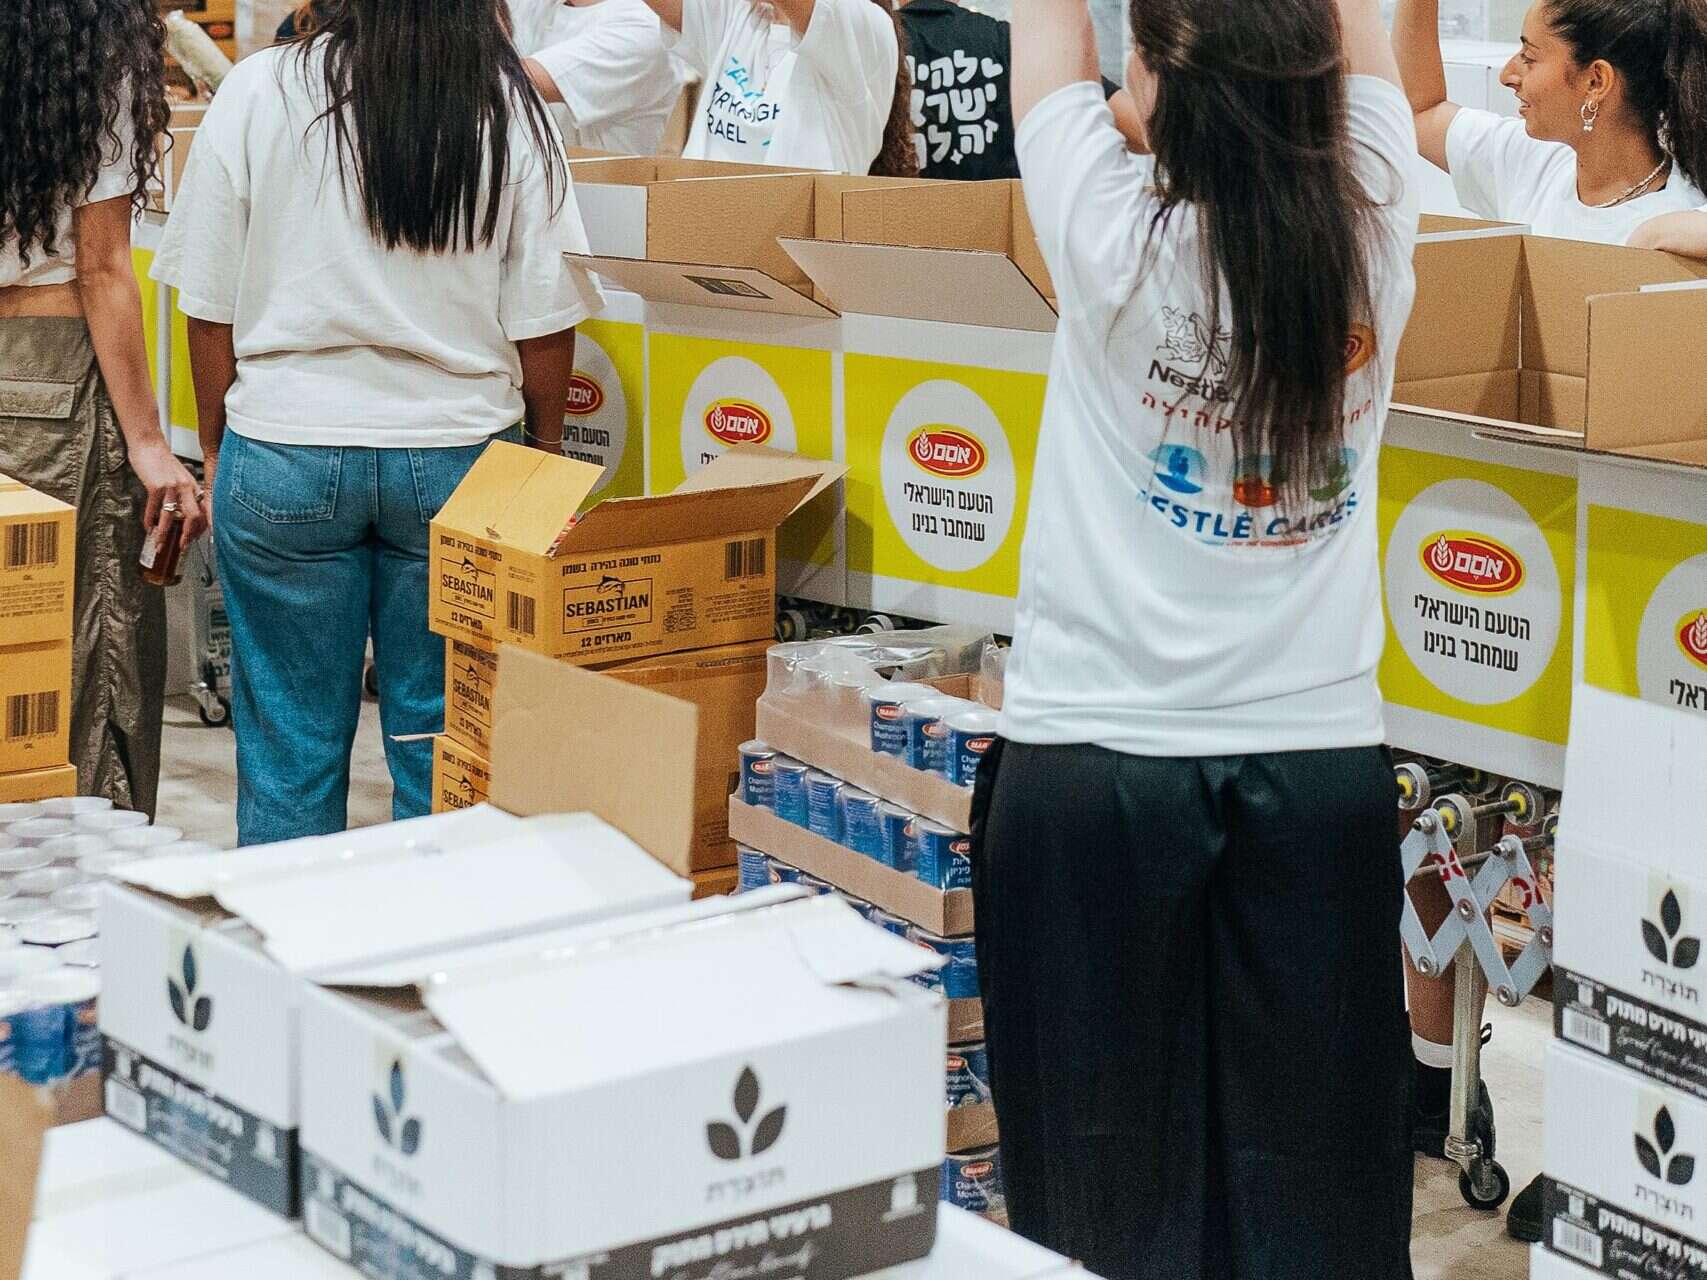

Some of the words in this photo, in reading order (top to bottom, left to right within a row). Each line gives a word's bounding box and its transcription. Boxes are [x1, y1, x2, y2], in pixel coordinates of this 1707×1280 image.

[707, 113, 747, 144] RAEL
[903, 481, 955, 508] הישראלי
[958, 490, 993, 514] הטעם
[940, 517, 985, 542] שמחבר
[442, 574, 494, 603] SEBASTIAN
[566, 593, 649, 618] SEBASTIAN
[1414, 593, 1480, 630] הישראלי
[594, 631, 632, 646] מארזים
[1484, 610, 1531, 641] הטעם
[580, 636, 592, 648] 12
[1460, 639, 1519, 672] שמחבר
[1670, 679, 1707, 711] ראלי
[443, 790, 474, 809] SEBAS
